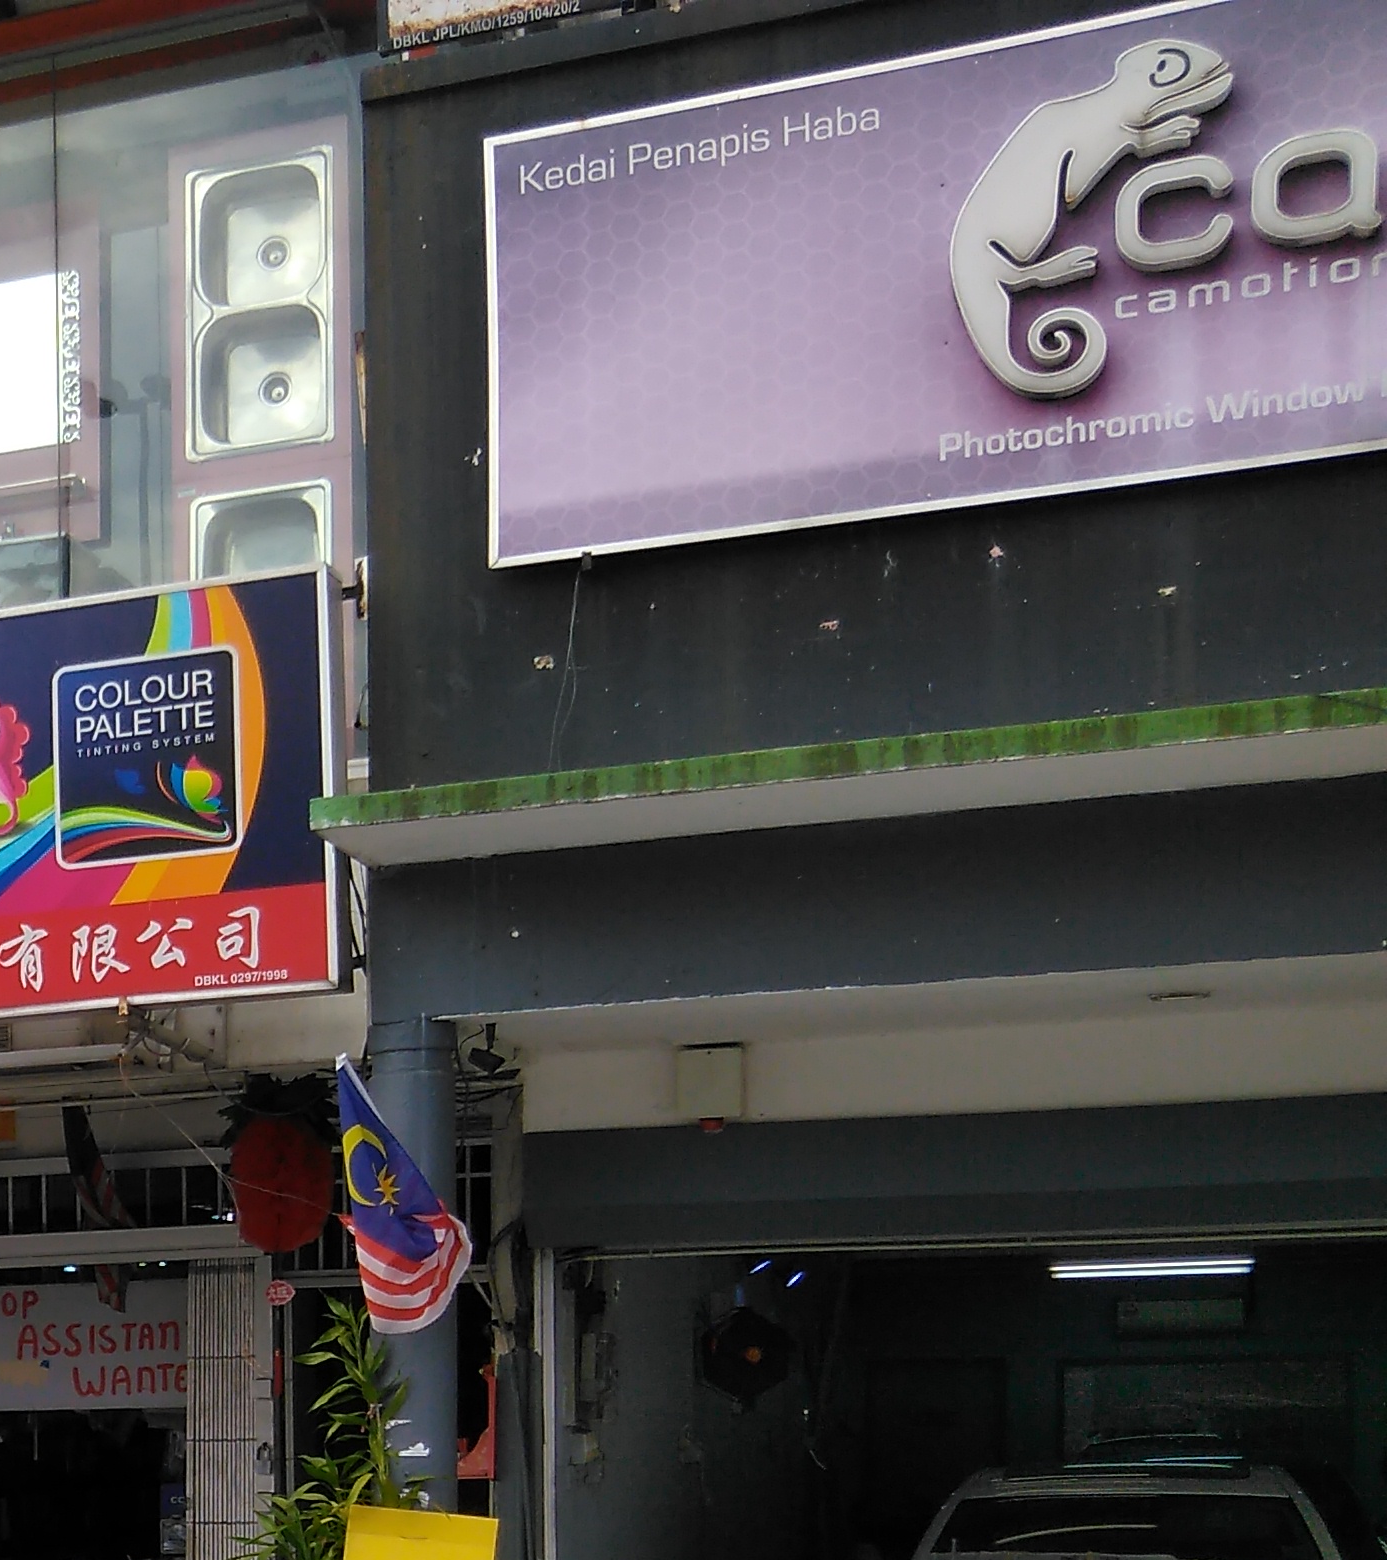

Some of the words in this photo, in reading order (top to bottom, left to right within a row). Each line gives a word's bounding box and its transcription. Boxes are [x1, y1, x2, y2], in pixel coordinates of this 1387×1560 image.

[393, 32, 430, 50] DBKL
[518, 148, 616, 195] Kedai
[627, 124, 771, 176] Penapis
[782, 105, 881, 147] Haba
[938, 403, 1195, 462] Photochromic
[1204, 378, 1364, 425] Window
[74, 668, 215, 713] COLOUR
[74, 702, 215, 744] PALETTE
[152, 733, 216, 750] SYSTEM
[77, 742, 143, 759] TINTING
[194, 971, 228, 988] DBKL
[229, 968, 289, 985] 0297/1998
[16, 1320, 187, 1361] ASSISTAN
[71, 1363, 188, 1398] WANTE
